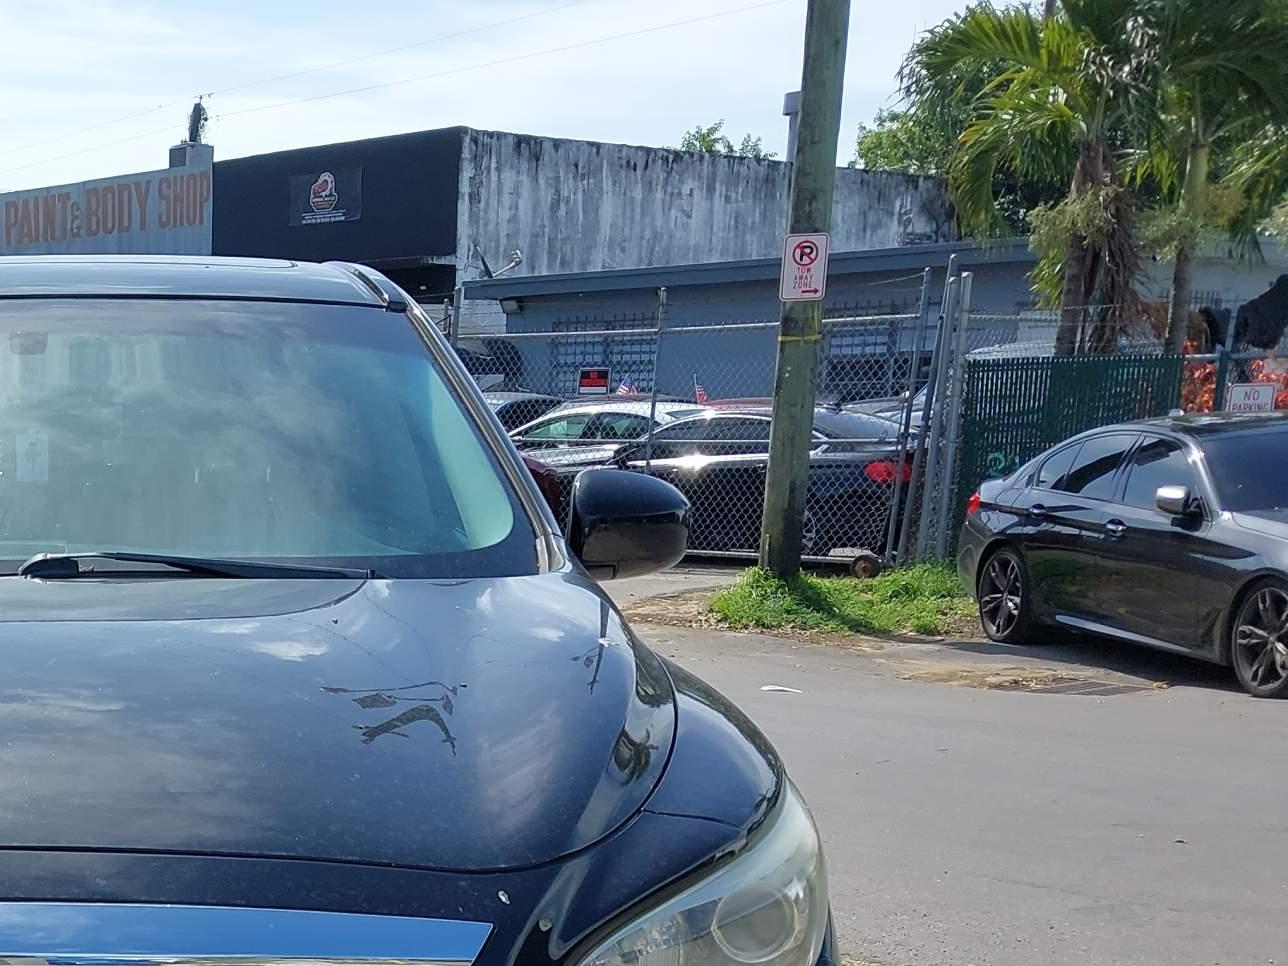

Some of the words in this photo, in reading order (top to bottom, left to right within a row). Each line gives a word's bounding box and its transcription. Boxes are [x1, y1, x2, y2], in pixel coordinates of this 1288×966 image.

[5, 193, 70, 245] PAINT
[86, 181, 152, 236] BODY
[158, 171, 211, 228] SHOP
[793, 280, 813, 289] ZONE
[1244, 390, 1260, 401] NO
